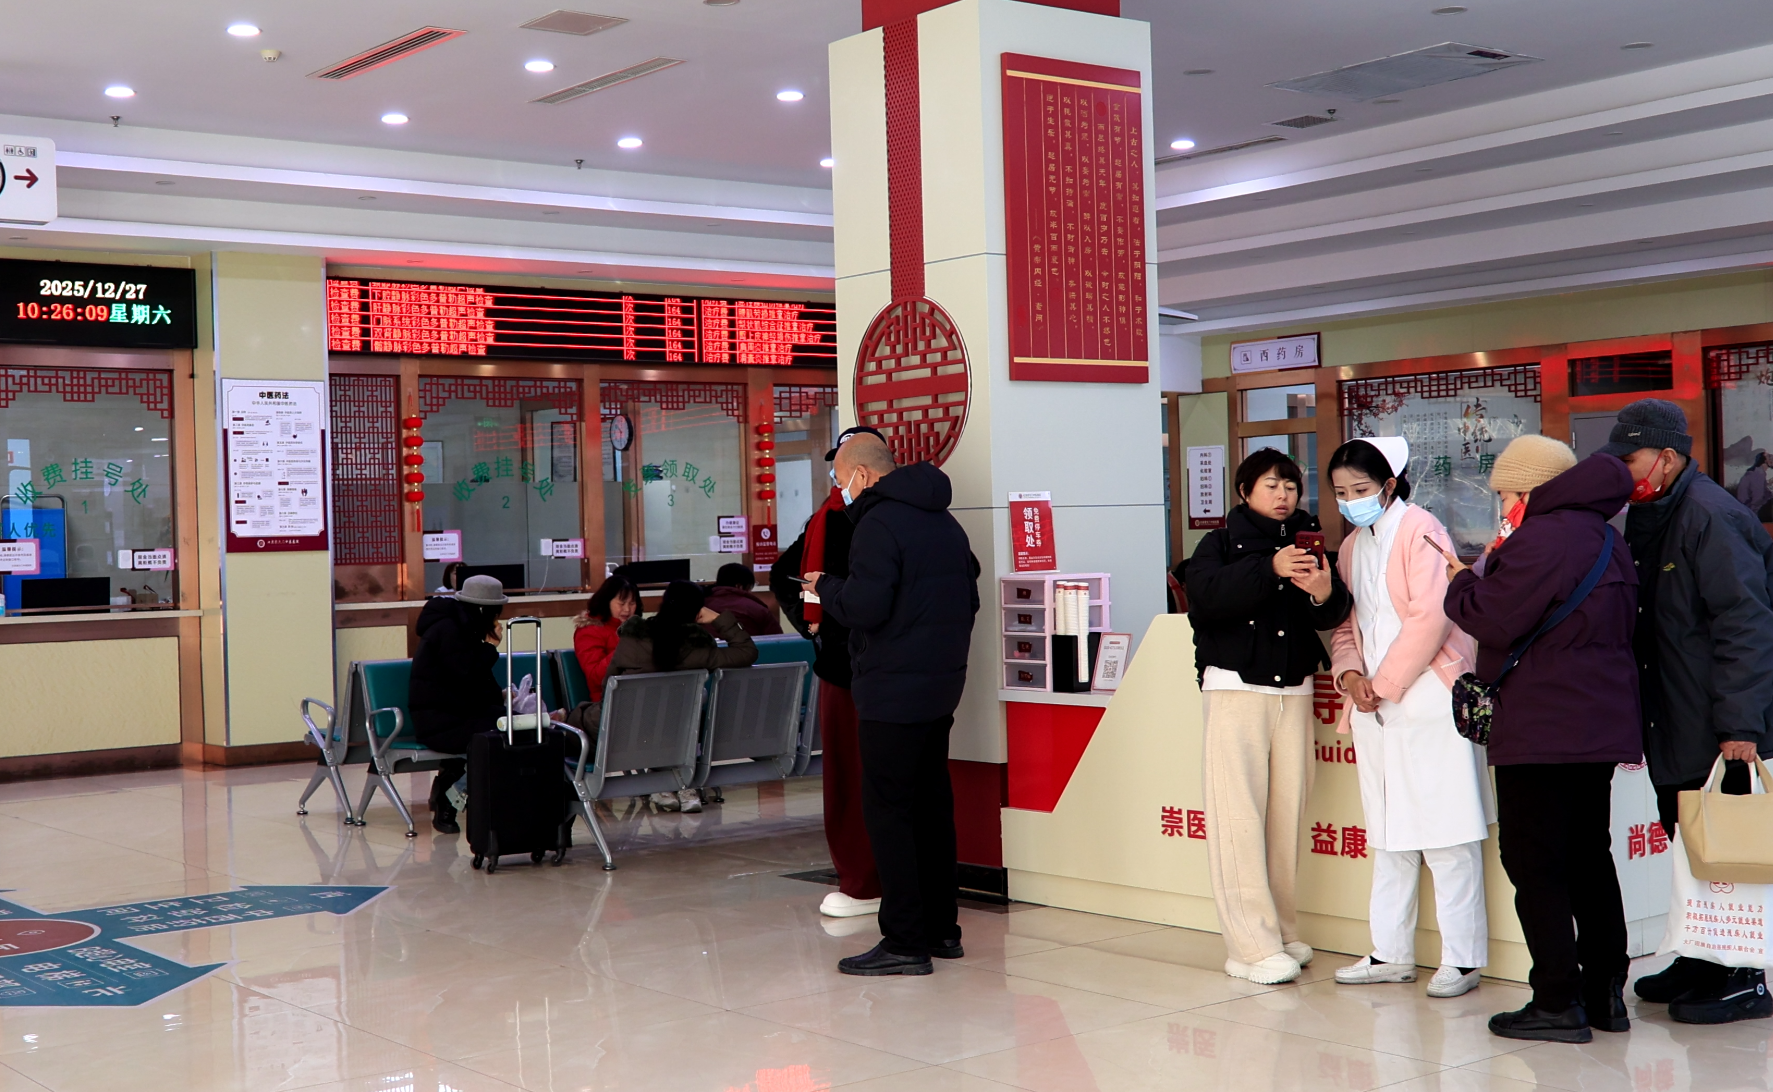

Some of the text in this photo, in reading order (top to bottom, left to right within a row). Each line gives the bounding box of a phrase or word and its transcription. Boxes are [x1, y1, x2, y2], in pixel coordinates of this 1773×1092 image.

[39, 279, 147, 300] 2025/12/27
[330, 287, 359, 299] 检查费
[668, 306, 681, 315] 164
[17, 302, 172, 325] 10:26:09 星期六
[331, 300, 360, 312] 检查费
[668, 318, 681, 326] 164
[704, 307, 728, 318] 治疗费
[705, 319, 728, 329] 治疗费
[331, 313, 360, 325] 检查费
[668, 329, 681, 338] 164
[705, 330, 729, 341] 治疗费
[331, 326, 360, 338] 检查费
[668, 341, 682, 350] 164
[705, 341, 729, 351] 治疗费
[331, 339, 361, 351] 检查费
[669, 353, 682, 361] 164
[706, 353, 729, 363] 治疗费
[1260, 344, 1304, 362] 西药房
[259, 391, 289, 399] 中医药法
[1433, 454, 1496, 477] 药房
[14, 457, 149, 505] 收费挂号处
[452, 456, 555, 502] 收费挂号处
[81, 500, 88, 515] 1
[502, 496, 510, 509] 2
[667, 494, 675, 507] 3
[1023, 507, 1035, 548] 领取处
[1315, 740, 1356, 764] uid
[1161, 806, 1207, 840] 崇医
[1311, 821, 1368, 860] 益康
[1628, 819, 1668, 860] 尚德
